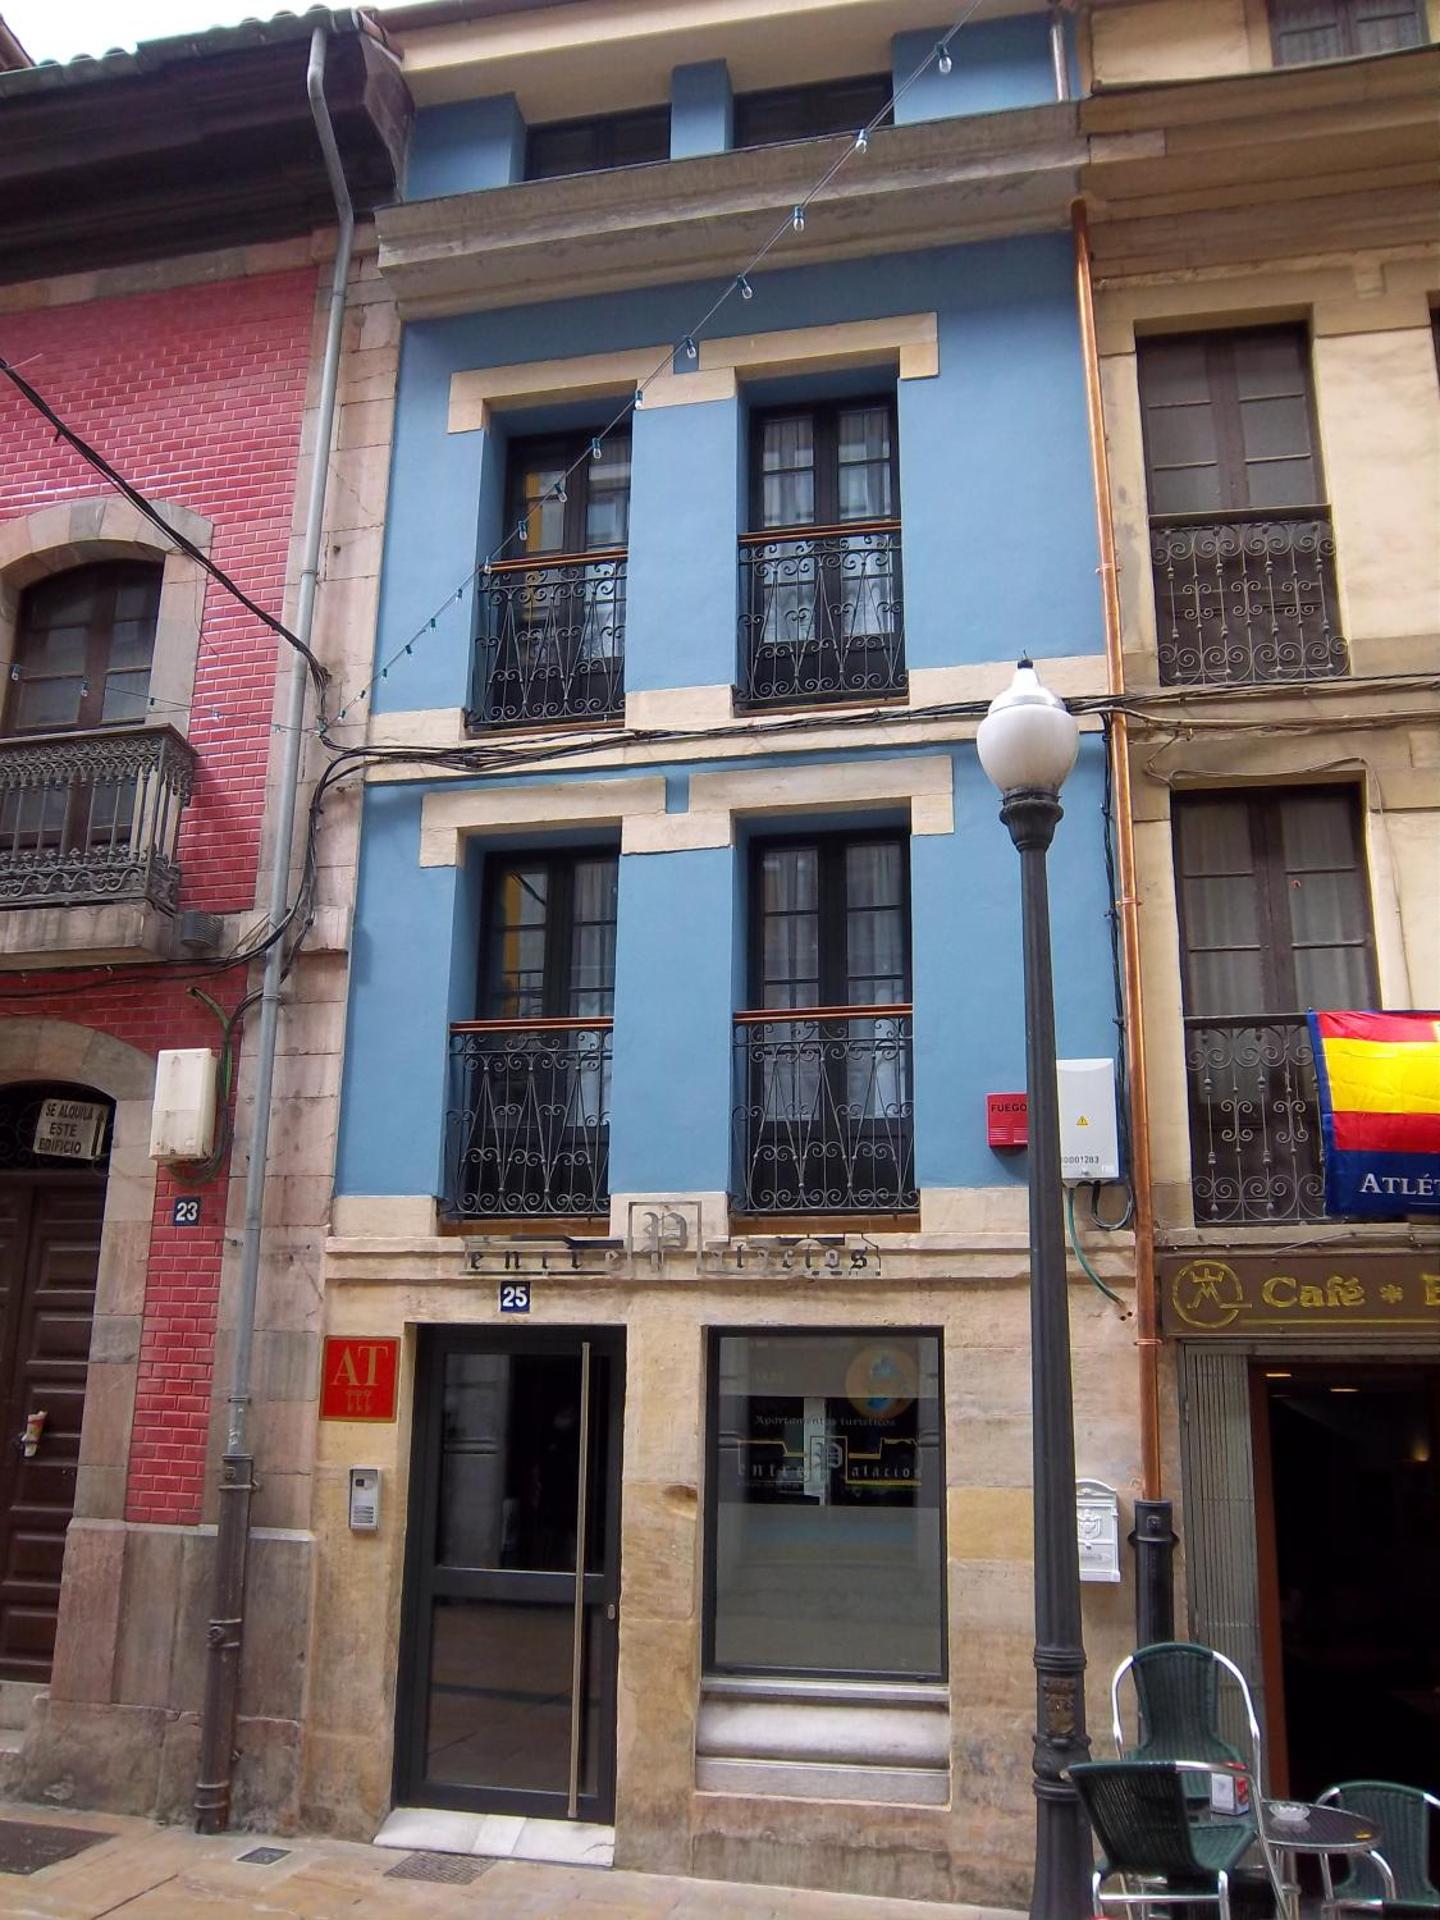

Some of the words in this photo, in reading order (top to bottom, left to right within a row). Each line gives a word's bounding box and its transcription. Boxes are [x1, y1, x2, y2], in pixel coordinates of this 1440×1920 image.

[46, 1103, 56, 1116] SE
[58, 1104, 93, 1120] ALQUILA
[991, 1103, 1027, 1112] FUEGO
[50, 1122, 77, 1137] ESTE
[38, 1138, 81, 1153] EDIFICIO
[176, 1202, 197, 1221] 23
[502, 1286, 527, 1307] 25
[1262, 1276, 1365, 1308] Café
[331, 1346, 388, 1385] AT
